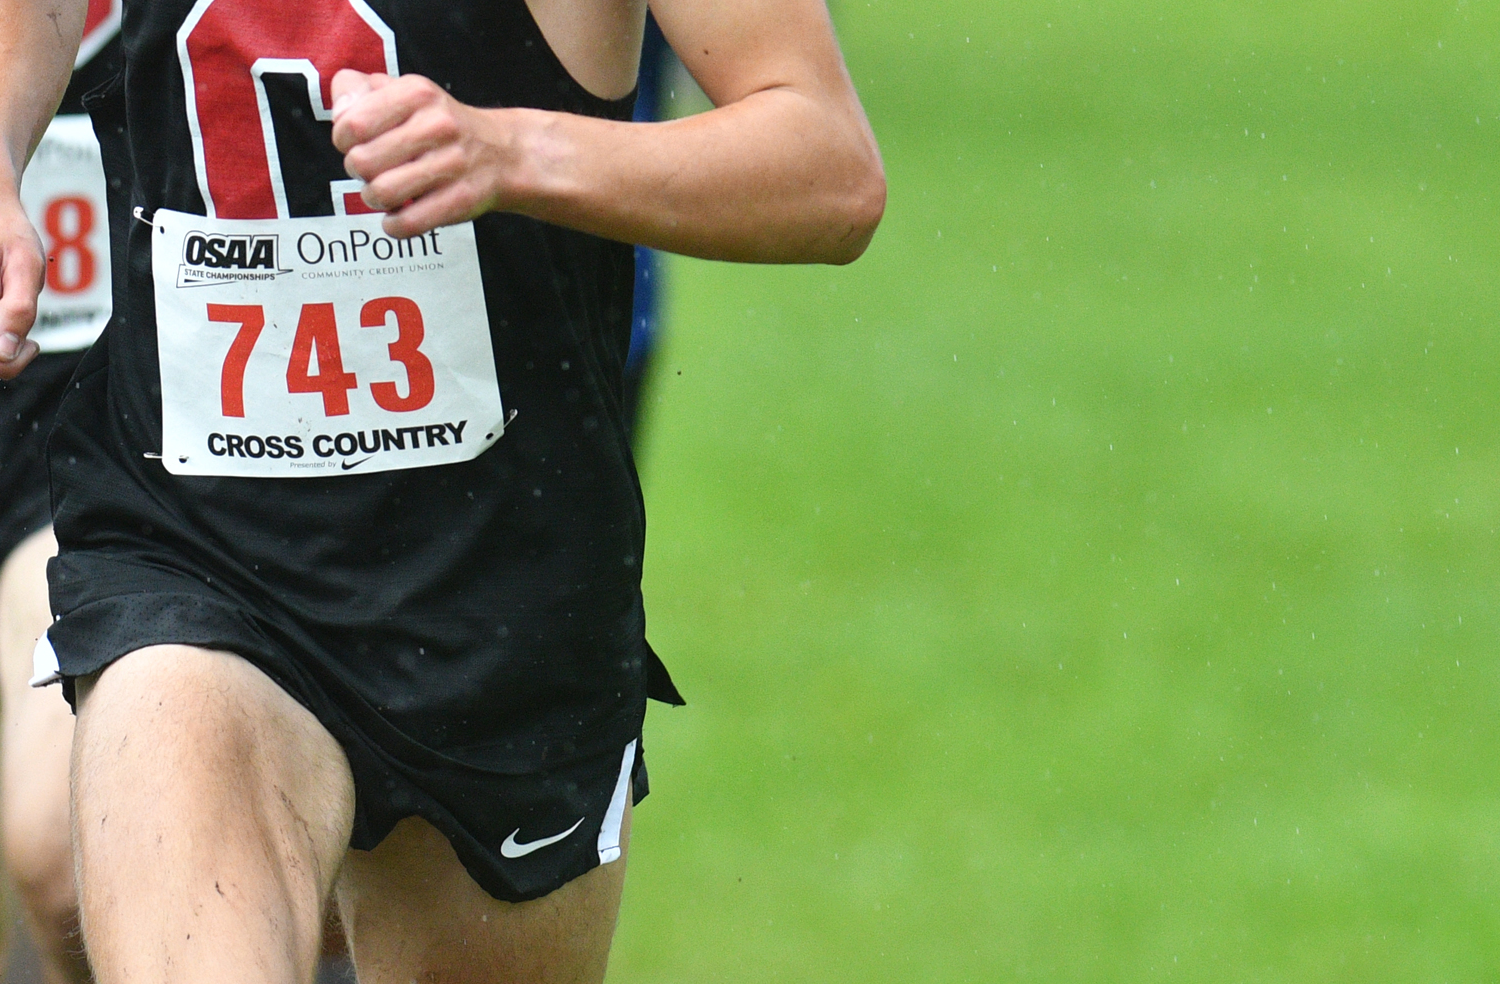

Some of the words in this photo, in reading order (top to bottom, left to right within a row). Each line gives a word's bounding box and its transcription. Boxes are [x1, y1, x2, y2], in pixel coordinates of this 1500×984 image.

[186, 235, 274, 269] OSAA
[184, 268, 204, 279] STATE
[206, 271, 275, 281] CHAMPIONSHIPS
[301, 268, 365, 280] COMMUNITY
[368, 266, 405, 277] CREDIT
[409, 262, 444, 273] UNION
[206, 296, 435, 418] 743
[208, 432, 304, 459] CROSS
[313, 420, 468, 458] COUNTRY
[289, 461, 326, 469] Presented
[327, 460, 337, 468] by
